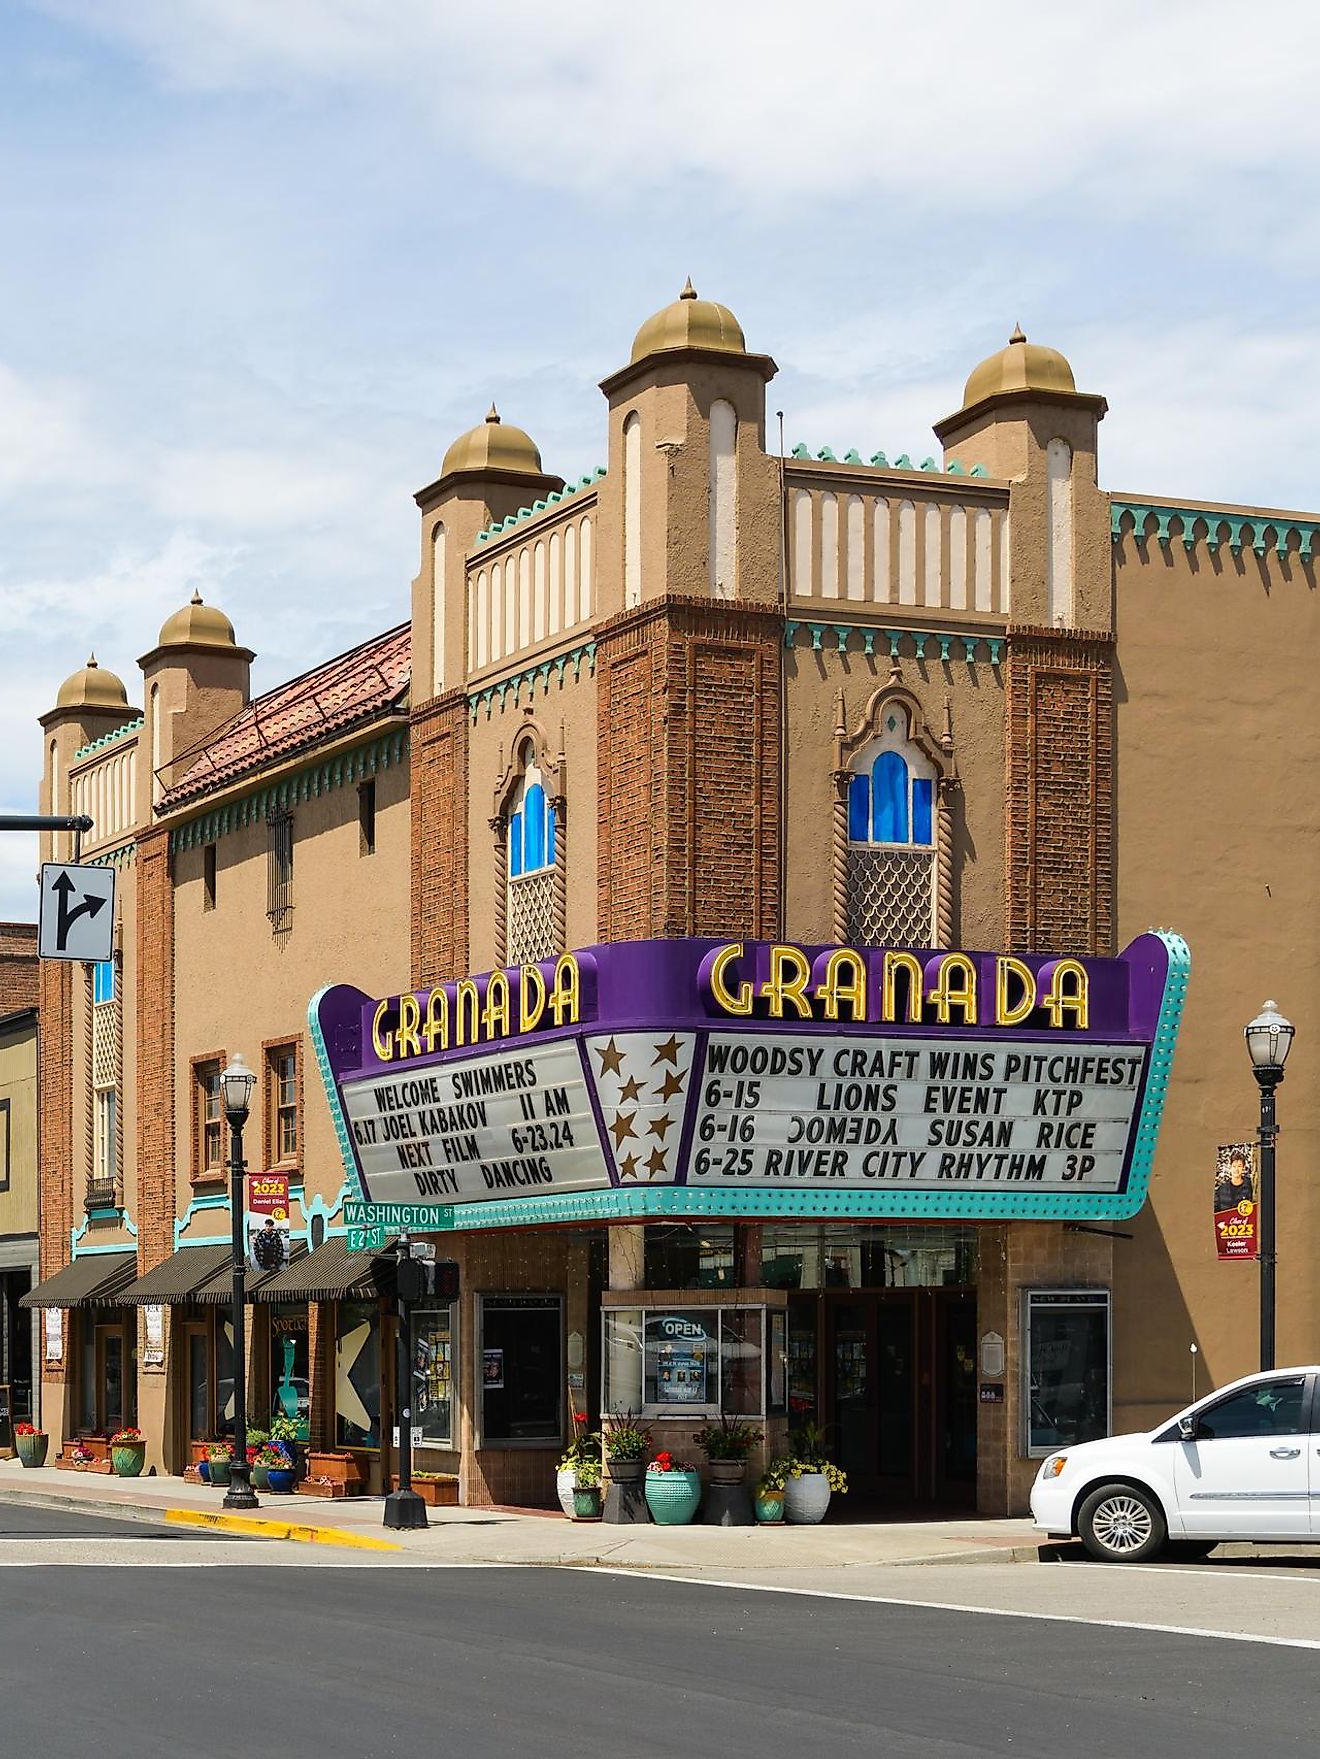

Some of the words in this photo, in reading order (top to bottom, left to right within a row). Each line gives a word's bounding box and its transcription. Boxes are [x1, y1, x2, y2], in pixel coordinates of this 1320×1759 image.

[710, 943, 1090, 1029] GRANADA
[372, 951, 579, 1062] GRANADA
[707, 1044, 824, 1076] WOODSY
[833, 1049, 919, 1079] CRAFT
[929, 1052, 995, 1082] WINS
[1004, 1054, 1142, 1085] PITCHFEST
[374, 1077, 440, 1113] WELCOME
[451, 1059, 537, 1100] SWIMMERS
[705, 1079, 761, 1108] 6-15
[816, 1082, 898, 1112] LIONS
[924, 1086, 1007, 1114] EVENT
[1032, 1089, 1083, 1116] KTP
[383, 1113, 417, 1141] JOEL
[419, 1101, 487, 1136] KABAKOV
[545, 1087, 571, 1117] AM
[699, 1114, 755, 1142] 6-16
[928, 1119, 1013, 1148] SUSAN
[1036, 1122, 1096, 1149] RICE
[396, 1142, 435, 1169] NEXT
[442, 1135, 480, 1163] FILM
[694, 1148, 754, 1175] 6-25
[764, 1149, 849, 1177] RIVER
[862, 1151, 927, 1178] CITY
[937, 1152, 1047, 1180] RHYTHM
[1062, 1154, 1096, 1181] 3P
[253, 1183, 285, 1194] 2023
[414, 1169, 459, 1196] DIRTY
[480, 1157, 553, 1189] DANCING
[346, 1204, 439, 1224] WASHINGTON
[443, 1208, 454, 1218] ST
[1220, 1224, 1254, 1236] 2023
[351, 1231, 357, 1247] E
[371, 1228, 381, 1245] ST
[664, 1323, 702, 1335] OPEN
